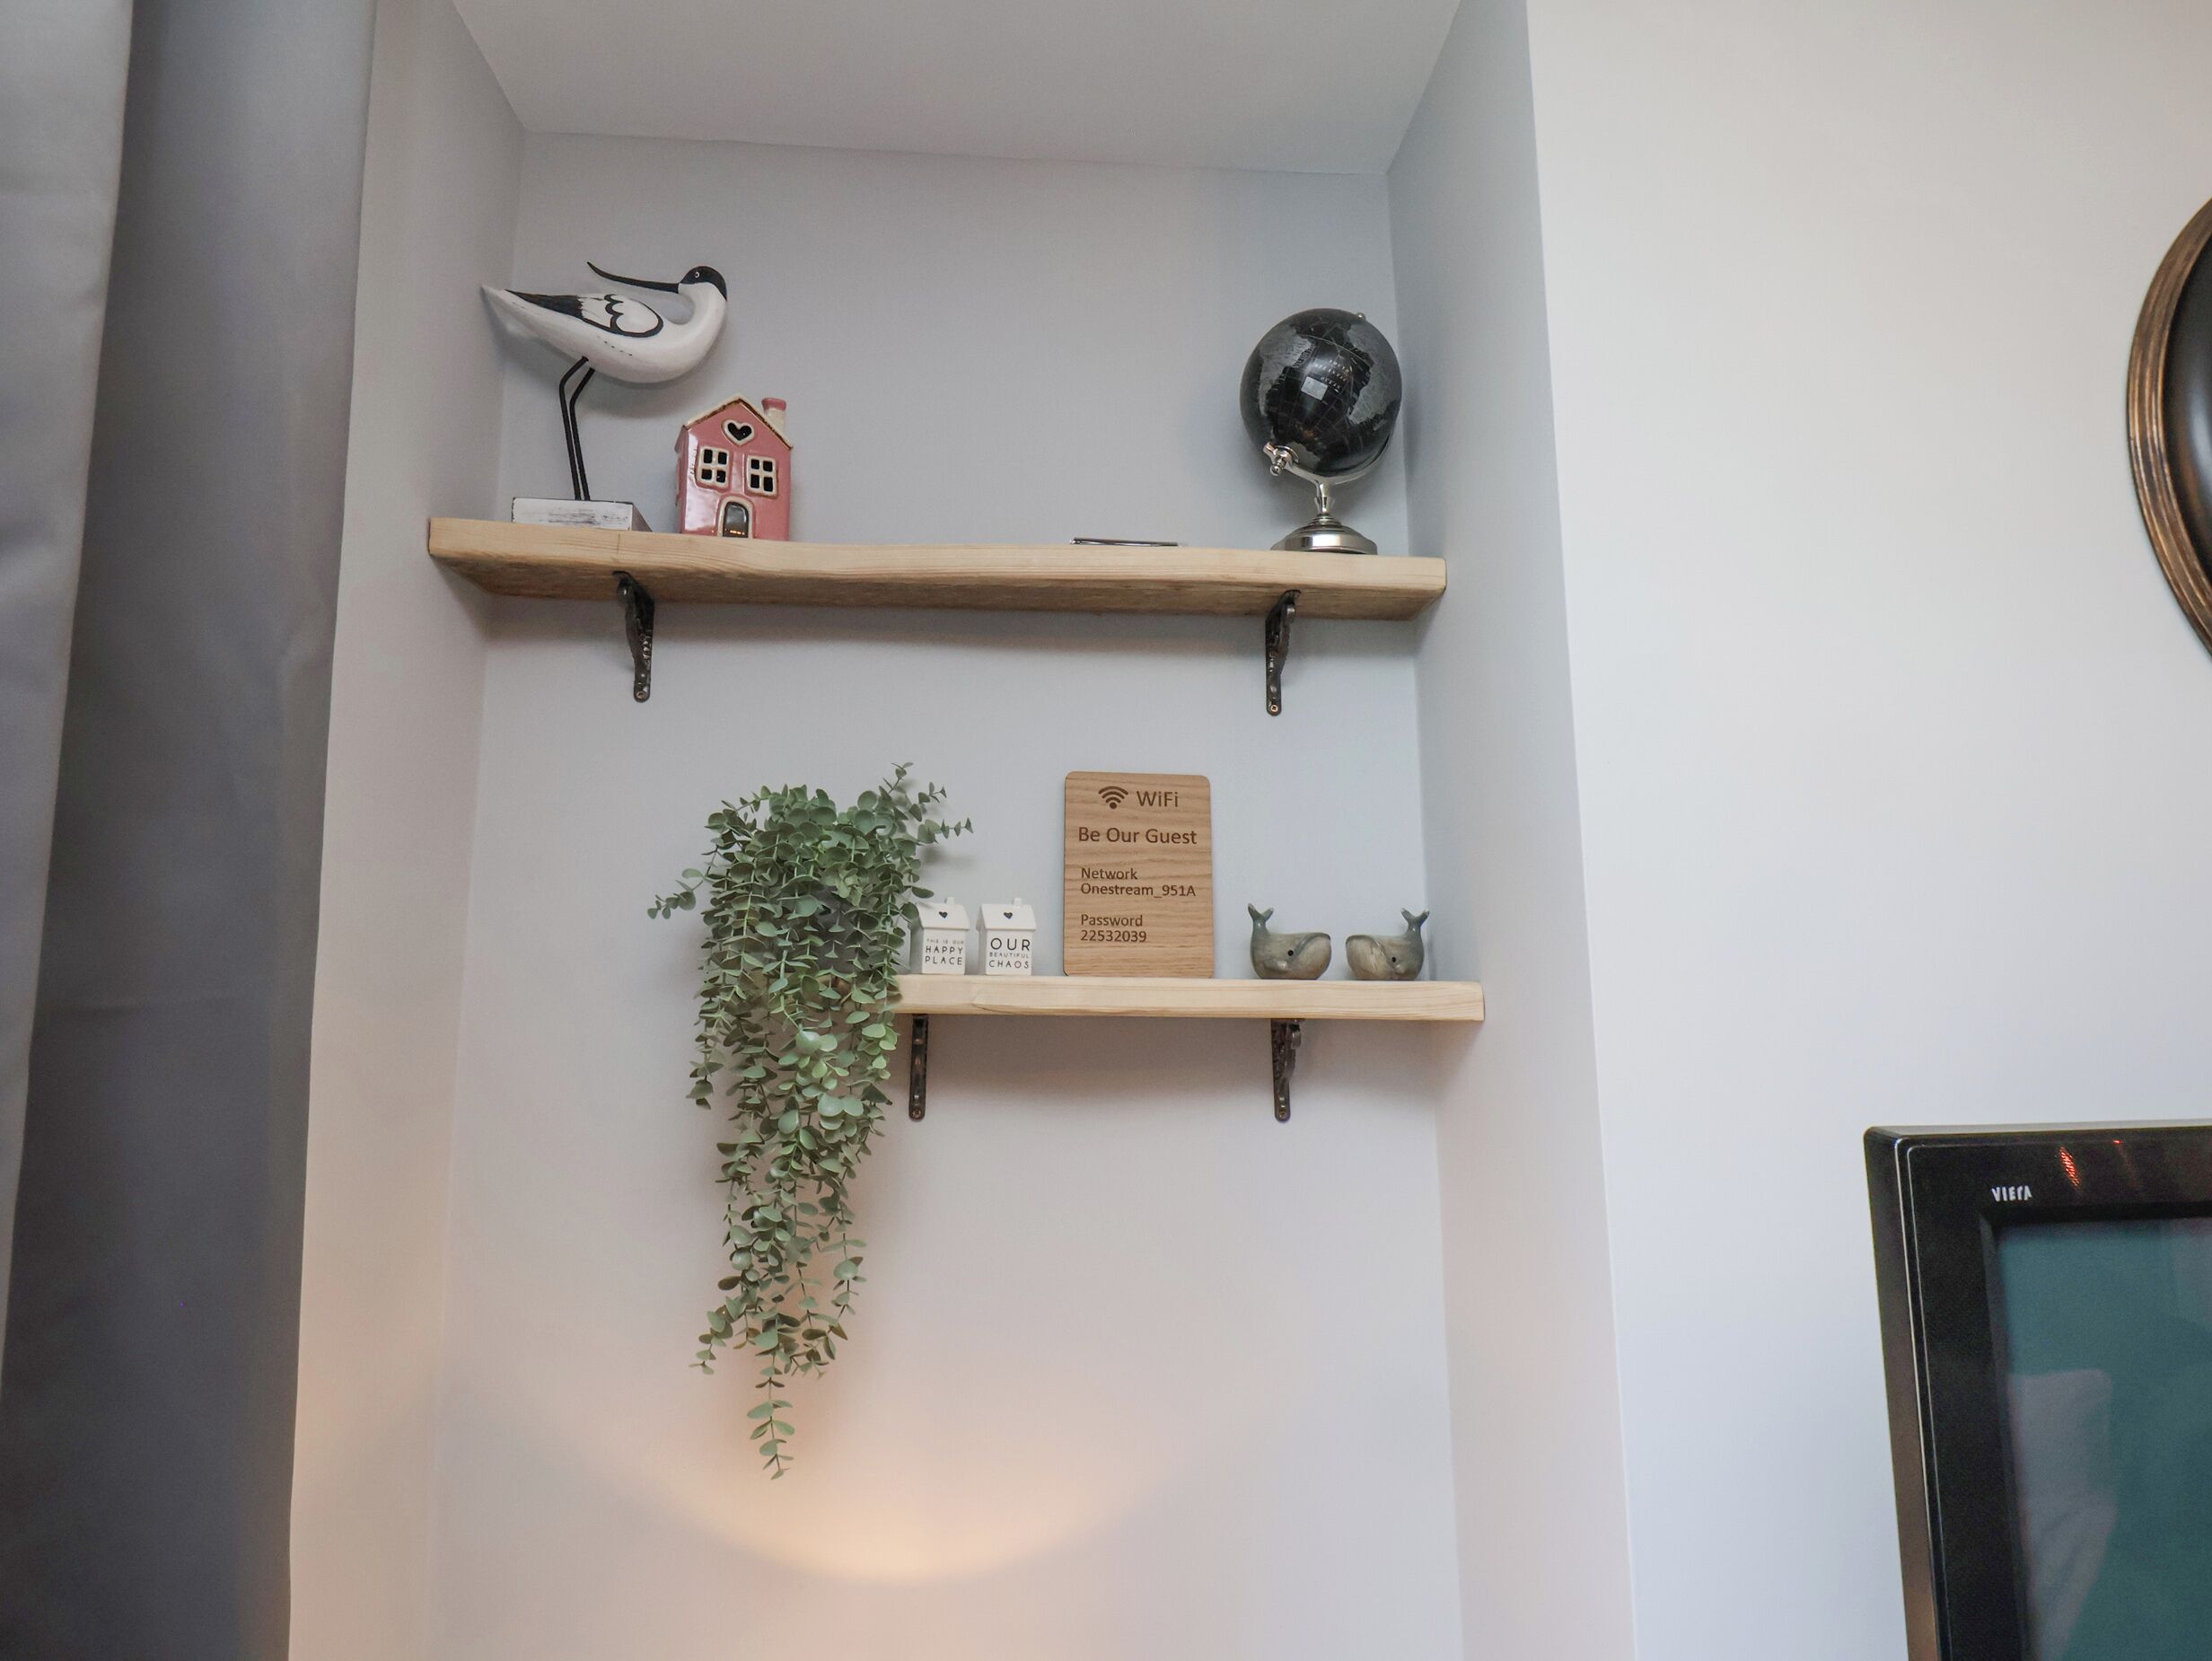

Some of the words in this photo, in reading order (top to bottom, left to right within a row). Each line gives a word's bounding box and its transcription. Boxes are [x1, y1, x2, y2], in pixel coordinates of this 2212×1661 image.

[1137, 790, 1179, 807] WiFi
[1078, 827, 1101, 842] Be
[1106, 827, 1140, 843] Our
[1146, 828, 1198, 845] Guest
[1081, 867, 1137, 880] Network
[1080, 883, 1197, 899] Onestream_951A
[1081, 914, 1143, 927] Password
[1080, 929, 1147, 943] 22532039
[926, 945, 963, 954] HAPPY
[990, 937, 1031, 952] OUR
[926, 956, 962, 965] PLACE
[988, 960, 1030, 969] CHAOS
